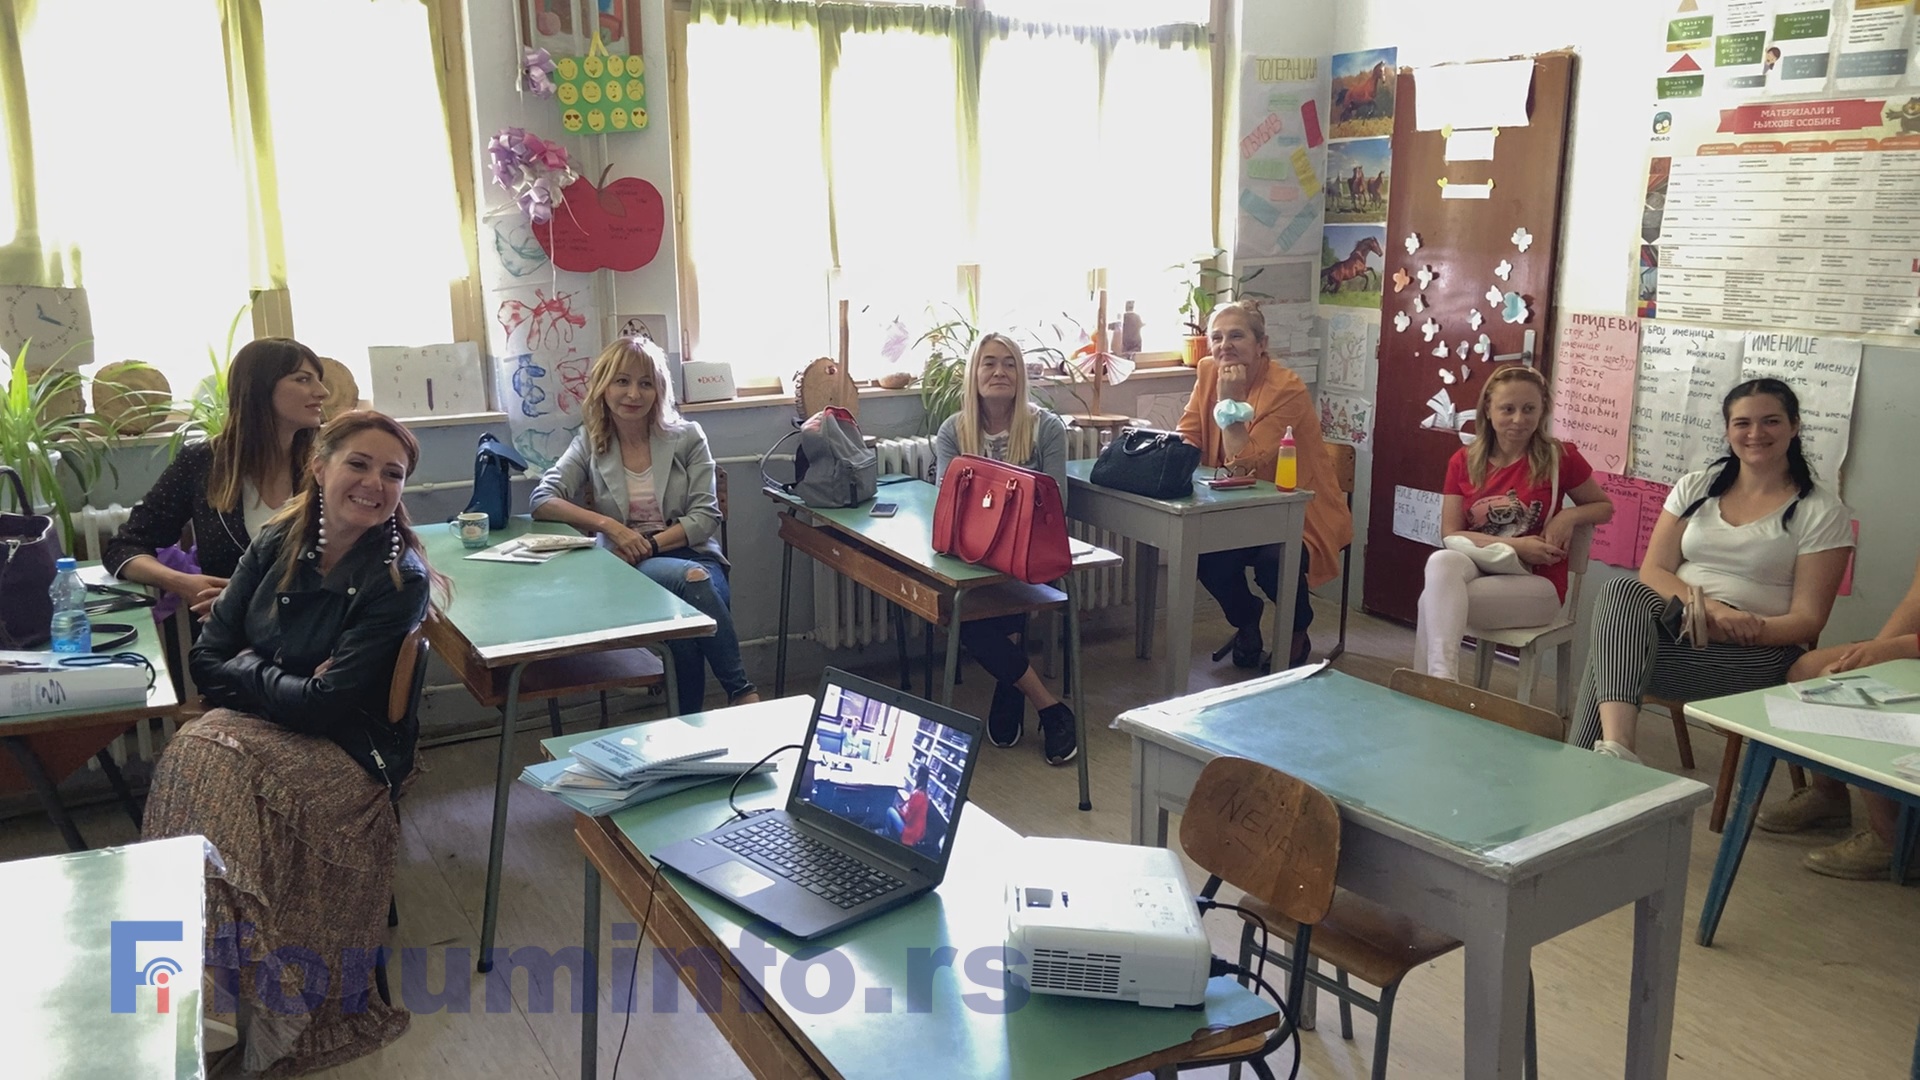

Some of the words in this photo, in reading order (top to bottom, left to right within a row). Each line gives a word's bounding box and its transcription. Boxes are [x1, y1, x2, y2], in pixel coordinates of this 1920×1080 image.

[1761, 107, 1823, 117] МАТЕРИЈАЛИ
[1826, 106, 1835, 114] И
[1753, 119, 1795, 129] ЊИХОВЕ
[1796, 117, 1842, 127] ОСОБИНЕ
[1572, 313, 1638, 334] ПРИДЕВИ
[1647, 325, 1666, 336] БРОЈ
[1751, 334, 1819, 356] ИМЕНИЦЕ
[1783, 359, 1805, 372] које
[1813, 362, 1857, 377] именују
[1635, 405, 1653, 420] РОД
